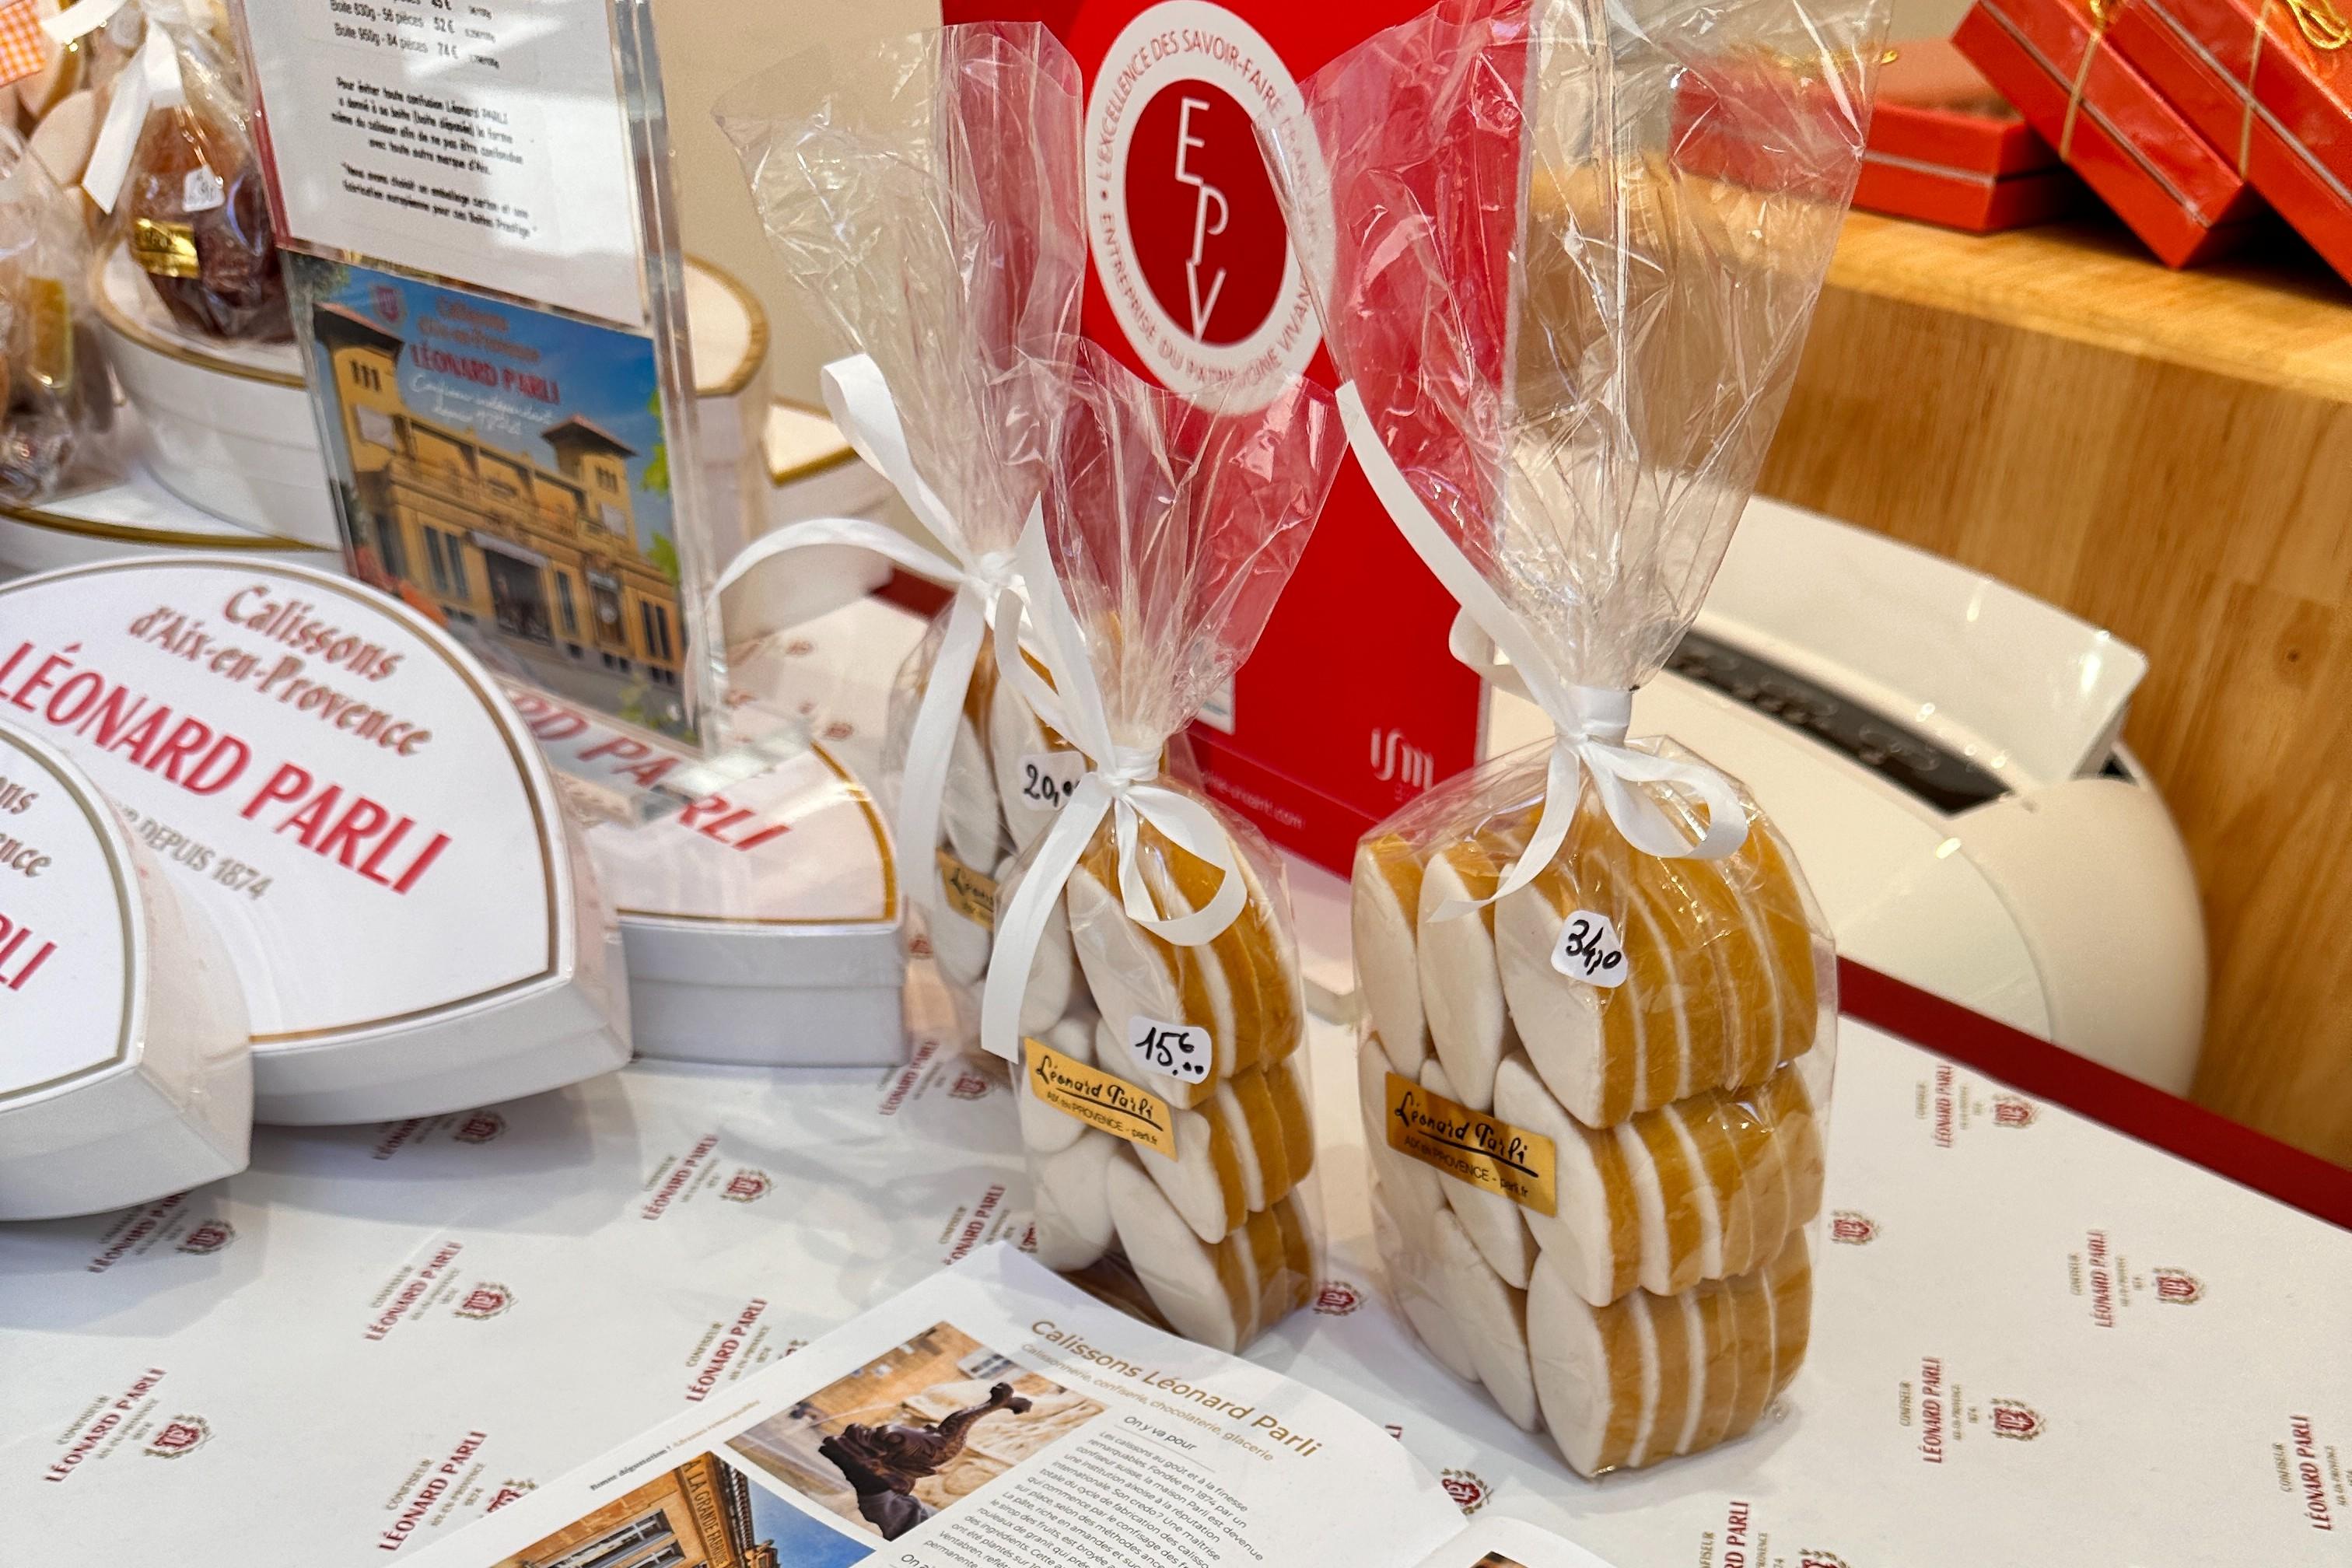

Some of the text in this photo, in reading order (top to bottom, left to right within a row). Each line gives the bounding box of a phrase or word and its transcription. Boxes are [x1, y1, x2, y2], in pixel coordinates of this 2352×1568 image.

[1150, 30, 1179, 61] DES
[1181, 29, 1284, 112] SAVOIR-FAIRE
[1157, 338, 1184, 370] DU
[1276, 281, 1312, 352] VIVAN
[222, 584, 405, 682] Calissons
[128, 604, 432, 757] d'Aix-en-Provence
[0, 640, 452, 895] LÉONARD PARLI
[138, 817, 274, 900] DEPUIS 1874
[1035, 1055, 1154, 1120] Léonard Parli
[1395, 1091, 1528, 1164] Léonard Parli
[1433, 1147, 1490, 1182] PROVENCE
[1032, 1320, 1322, 1458] Calissons Léonard Parli
[1124, 1416, 1143, 1427] On
[1152, 1428, 1167, 1437] va
[1164, 1435, 1197, 1450] pour
[1222, 1431, 1274, 1462] glacerie
[1100, 1497, 1113, 1506] de
[1112, 1503, 1160, 1534] fabrication
[1160, 1532, 1179, 1546] des
[1129, 1500, 1157, 1516] credo
[1162, 1517, 1183, 1531] Une
[1153, 1482, 1187, 1503] maison
[1186, 1500, 1210, 1517] Parli
[1208, 1515, 1224, 1528] est
[1223, 1526, 1263, 1561] devenue
[1214, 1505, 1234, 1517] par
[1233, 1517, 1247, 1528] un
[1215, 1488, 1248, 1512] finesse
[1726, 1501, 1749, 1547] PARLI
[1013, 1525, 1027, 1534] de
[1053, 1547, 1070, 1558] qui
[1057, 1519, 1070, 1528] en
[1070, 1525, 1113, 1552] amandes
[1112, 1550, 1125, 1559] et
[1078, 1514, 1096, 1525] des
[1094, 1524, 1142, 1555] méthodes
[1090, 1507, 1108, 1517] par
[1116, 1521, 1160, 1550] confisage
[1160, 1549, 1179, 1564] des
[1171, 1508, 1220, 1542] réputation
